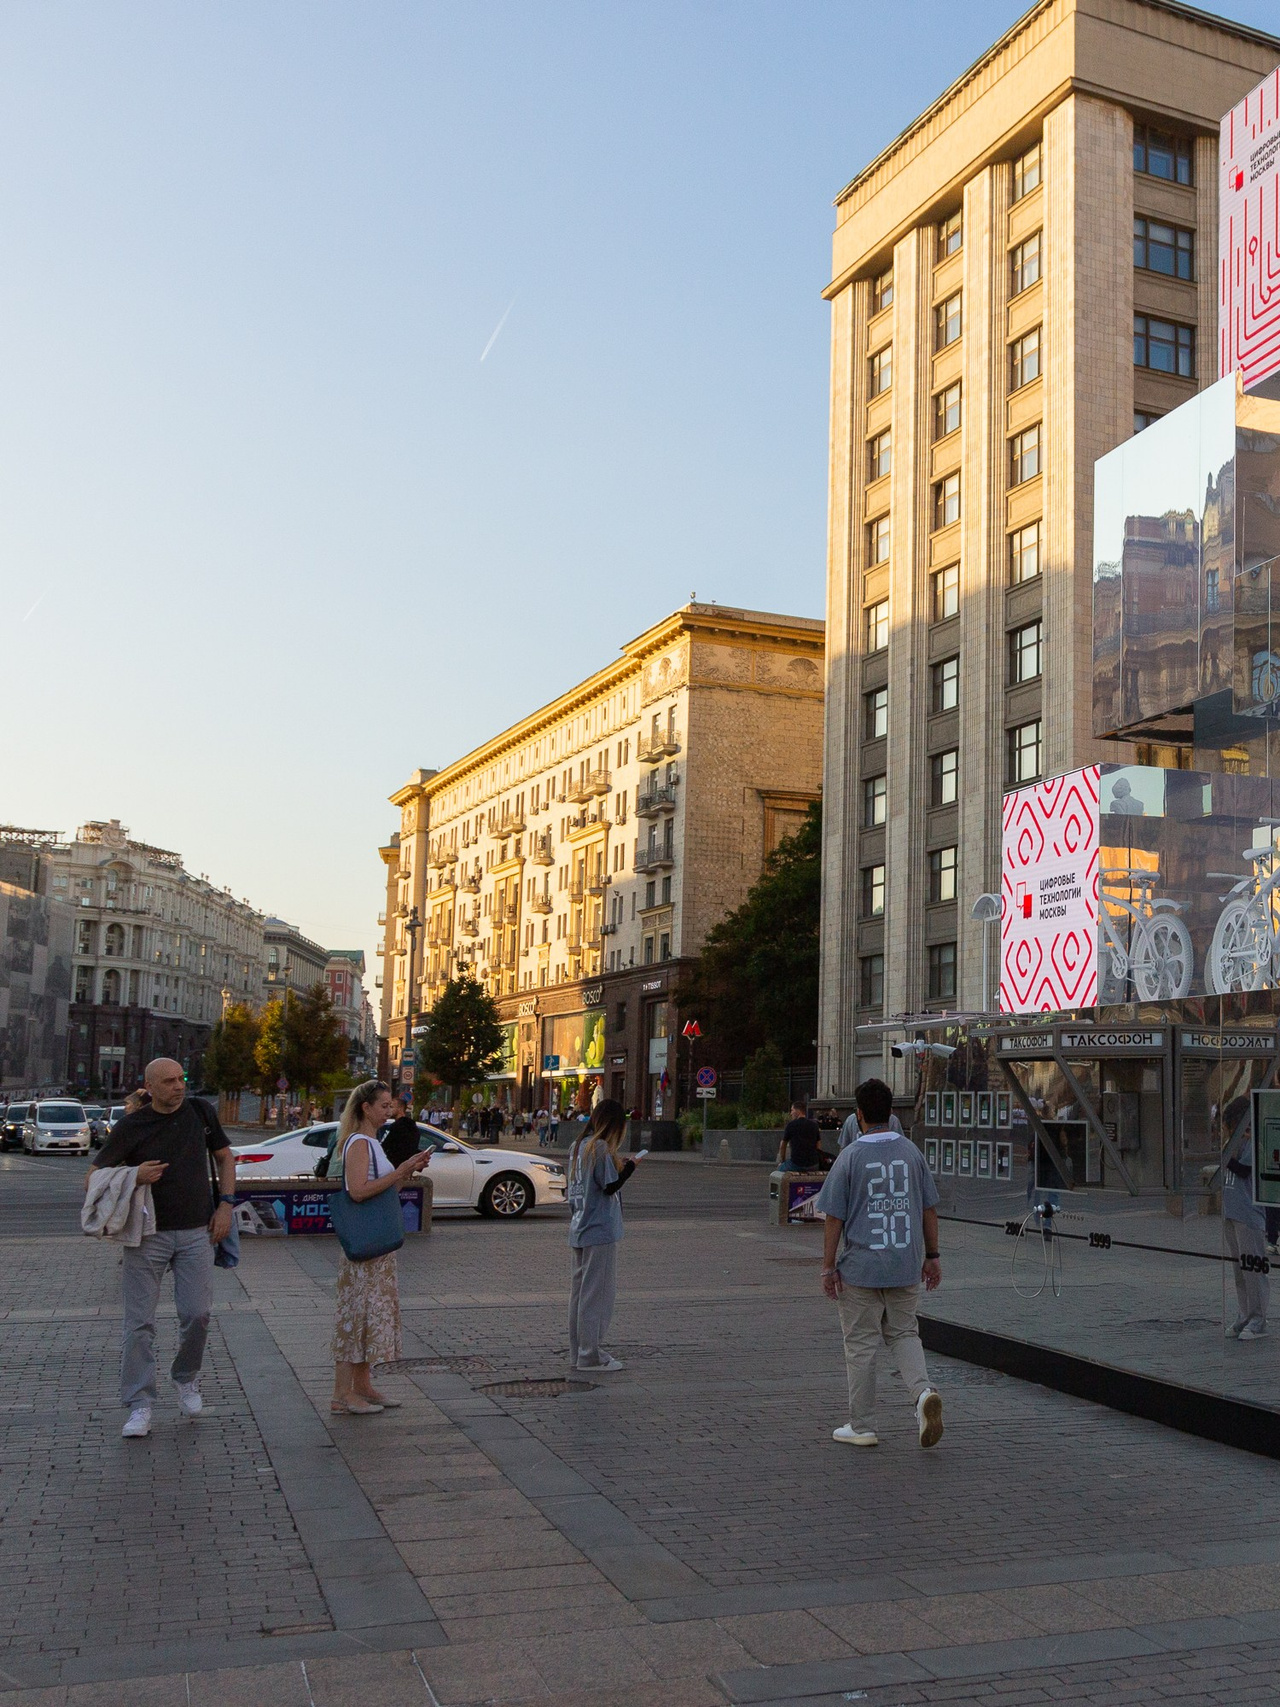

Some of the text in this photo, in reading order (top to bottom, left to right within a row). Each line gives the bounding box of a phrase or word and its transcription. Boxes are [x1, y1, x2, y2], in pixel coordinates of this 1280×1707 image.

[1250, 157, 1274, 183] МОСКВЫ
[1040, 872, 1076, 892] ЦИФРОВЫЕ
[1040, 886, 1082, 906] ТЕХНОЛОГИИ
[1040, 905, 1066, 920] МОСКВЫ
[1010, 1036, 1048, 1050] ТАКСОФОН
[1068, 1033, 1152, 1048] ТАКСОФОН
[866, 1160, 908, 1198] 20
[868, 1198, 910, 1212] МОСКВА
[868, 1211, 910, 1250] 30
[1089, 1232, 1111, 1249] 1999
[1240, 1253, 1270, 1274] 1996
